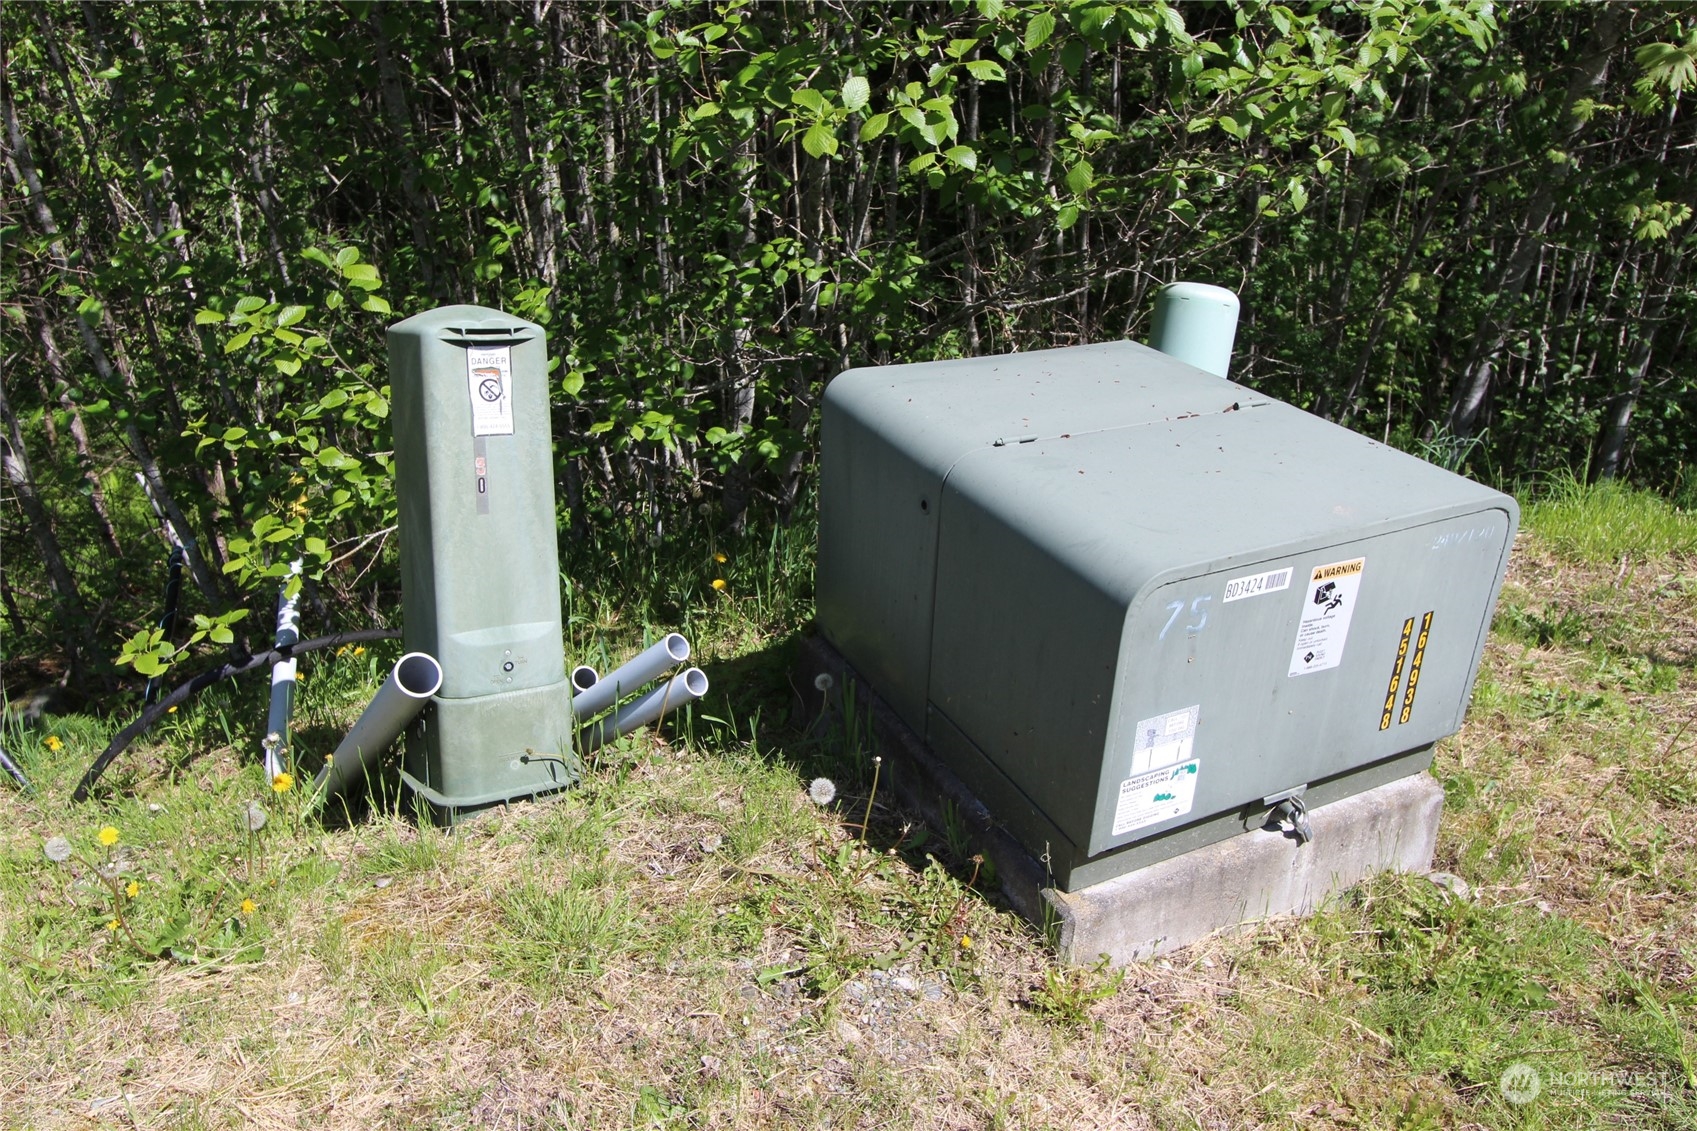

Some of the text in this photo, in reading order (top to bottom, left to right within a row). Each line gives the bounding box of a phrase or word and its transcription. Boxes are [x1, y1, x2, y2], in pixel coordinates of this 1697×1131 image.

[471, 357, 507, 366] DANGER
[1323, 562, 1362, 578] WARNING
[1225, 576, 1264, 599] BD3424
[1158, 594, 1212, 641] 75
[1380, 618, 1413, 730] 451648
[1400, 611, 1432, 724] 164938
[1121, 776, 1169, 794] SUGGESTIONS
[1122, 769, 1170, 788] LANDSCAPING
